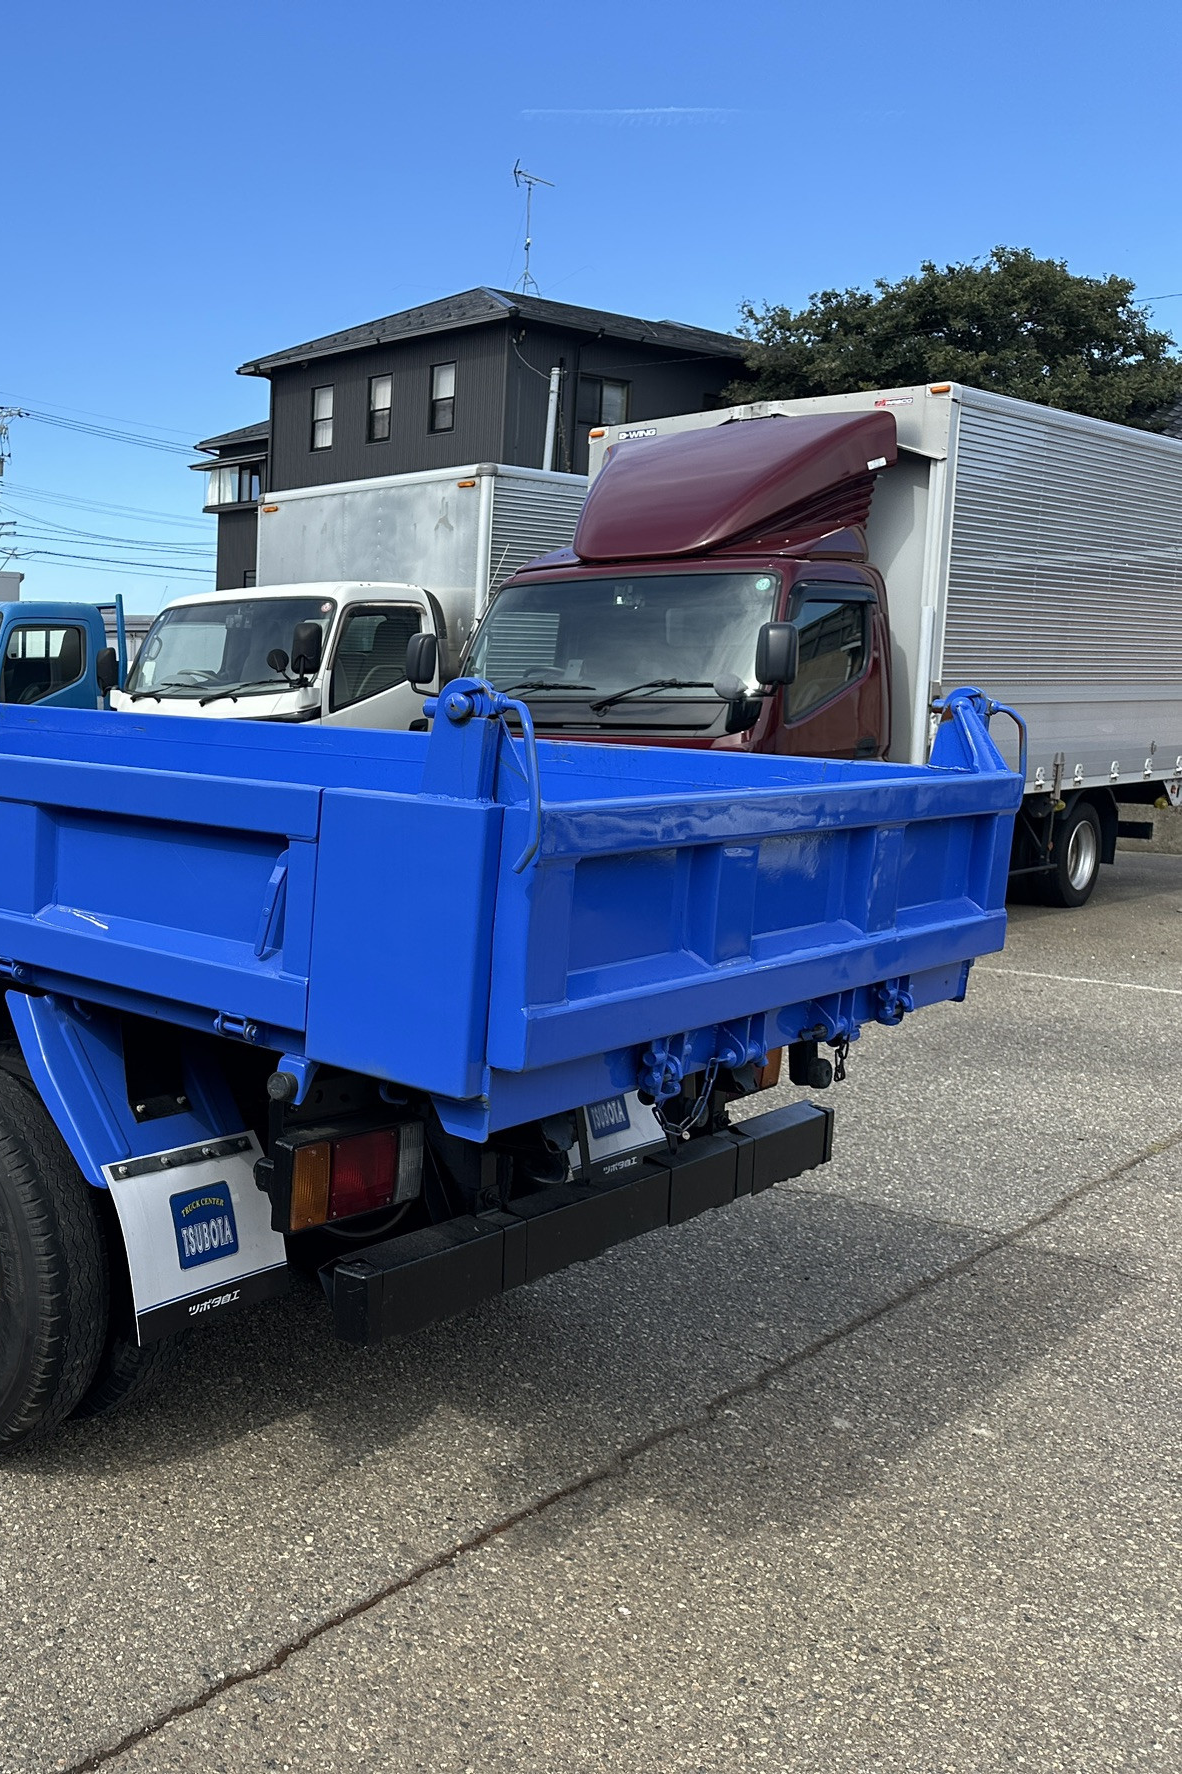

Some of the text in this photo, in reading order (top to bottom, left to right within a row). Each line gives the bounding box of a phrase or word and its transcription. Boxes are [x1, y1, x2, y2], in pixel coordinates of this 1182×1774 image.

[182, 1197, 224, 1217] TRUCK CENTER
[181, 1215, 234, 1257] TSUBOTA
[188, 1289, 241, 1316] ツボタ自工
